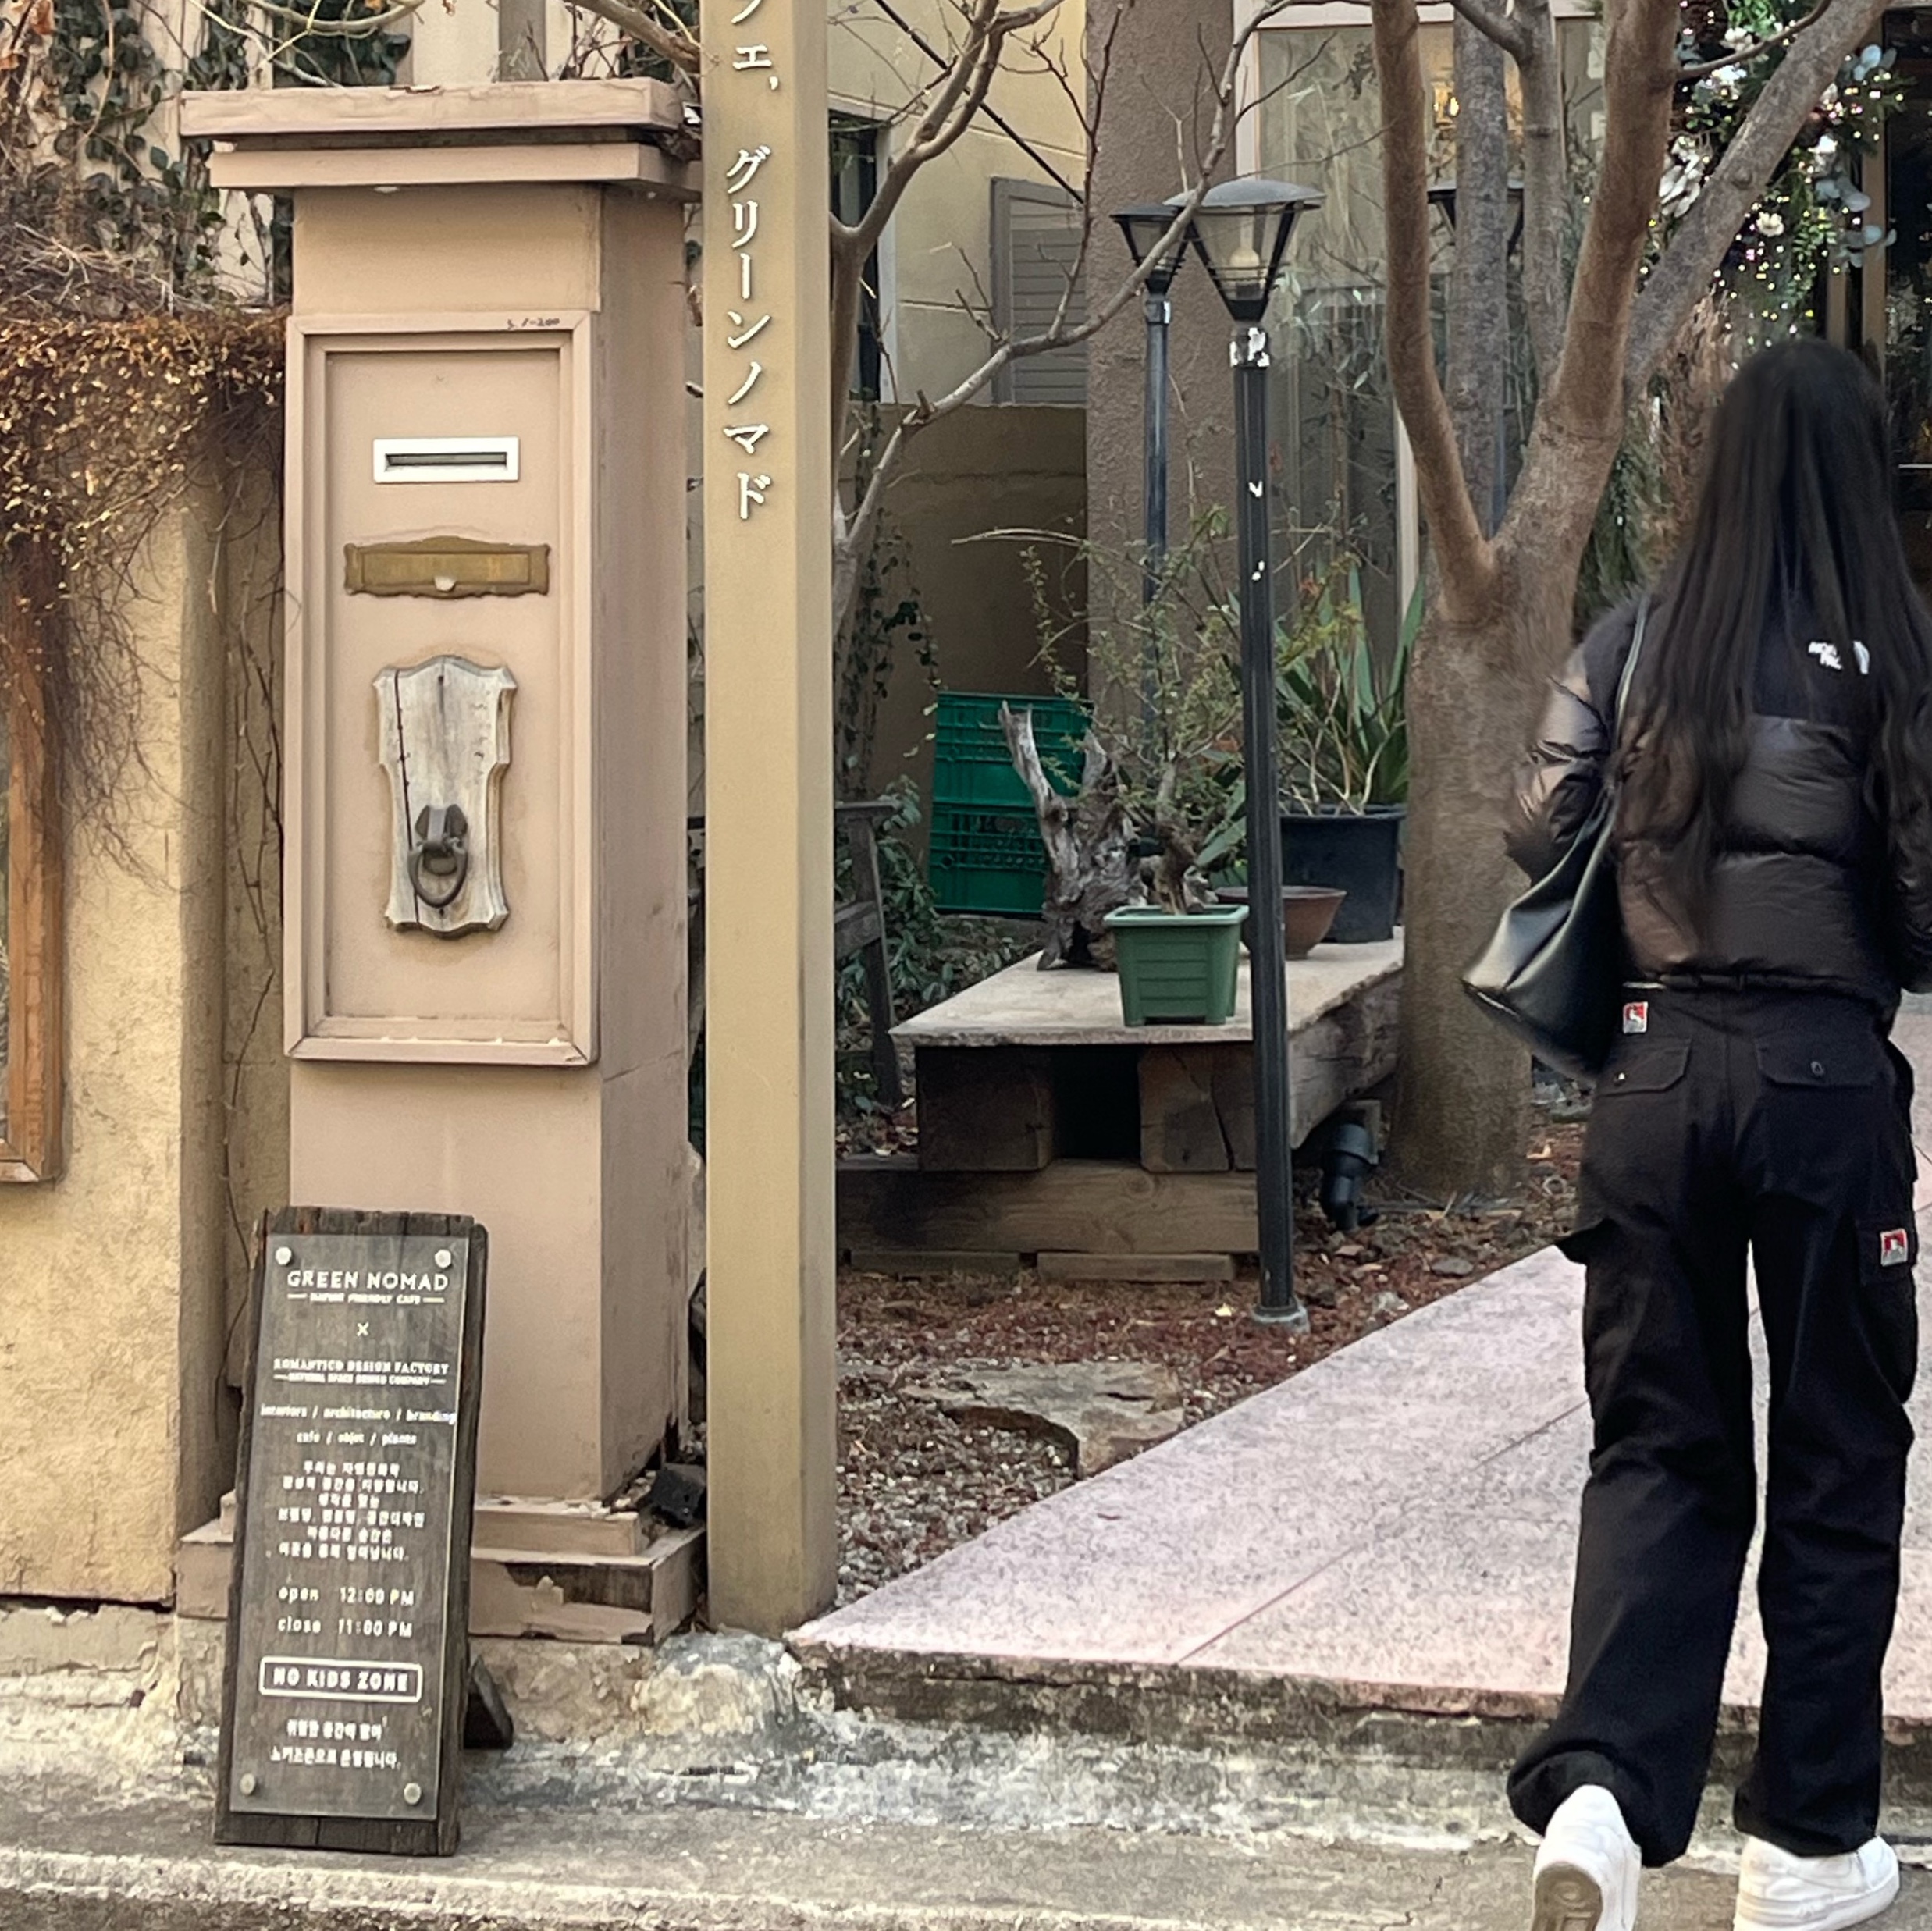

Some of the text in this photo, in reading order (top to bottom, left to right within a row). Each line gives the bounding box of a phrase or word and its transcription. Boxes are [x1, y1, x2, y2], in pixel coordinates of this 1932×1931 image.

[724, 145, 772, 521] グリーンノマド
[287, 1269, 448, 1292] GREEN NOMAD
[347, 1360, 391, 1373] DESIGN
[393, 1361, 449, 1377] FACTORY
[279, 1586, 414, 1606] open 12:00 PM
[278, 1616, 412, 1638] close 11:00 PM
[273, 1667, 408, 1692] NO KIDS ZONE
